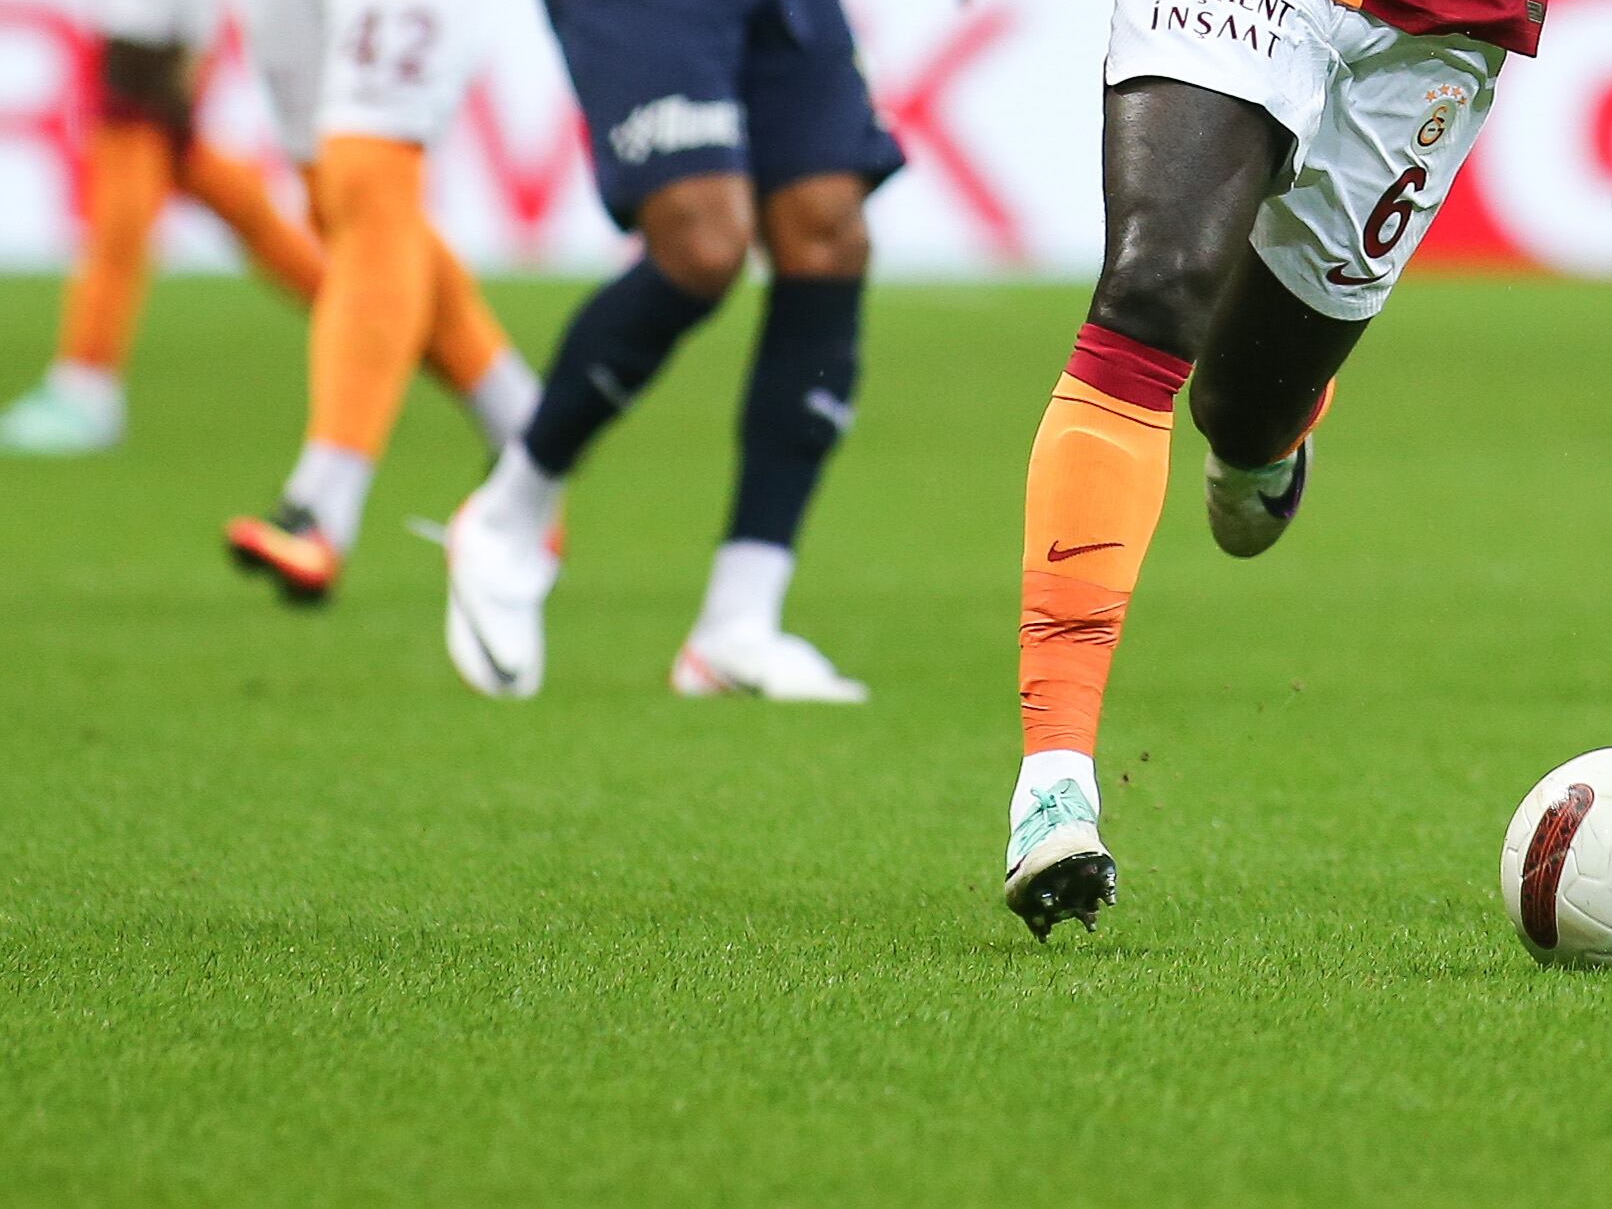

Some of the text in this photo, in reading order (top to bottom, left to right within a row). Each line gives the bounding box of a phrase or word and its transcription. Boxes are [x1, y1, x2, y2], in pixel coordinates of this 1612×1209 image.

[342, 4, 440, 85] 42
[1151, 1, 1282, 58] İNŞAAT
[1363, 166, 1427, 259] 6
